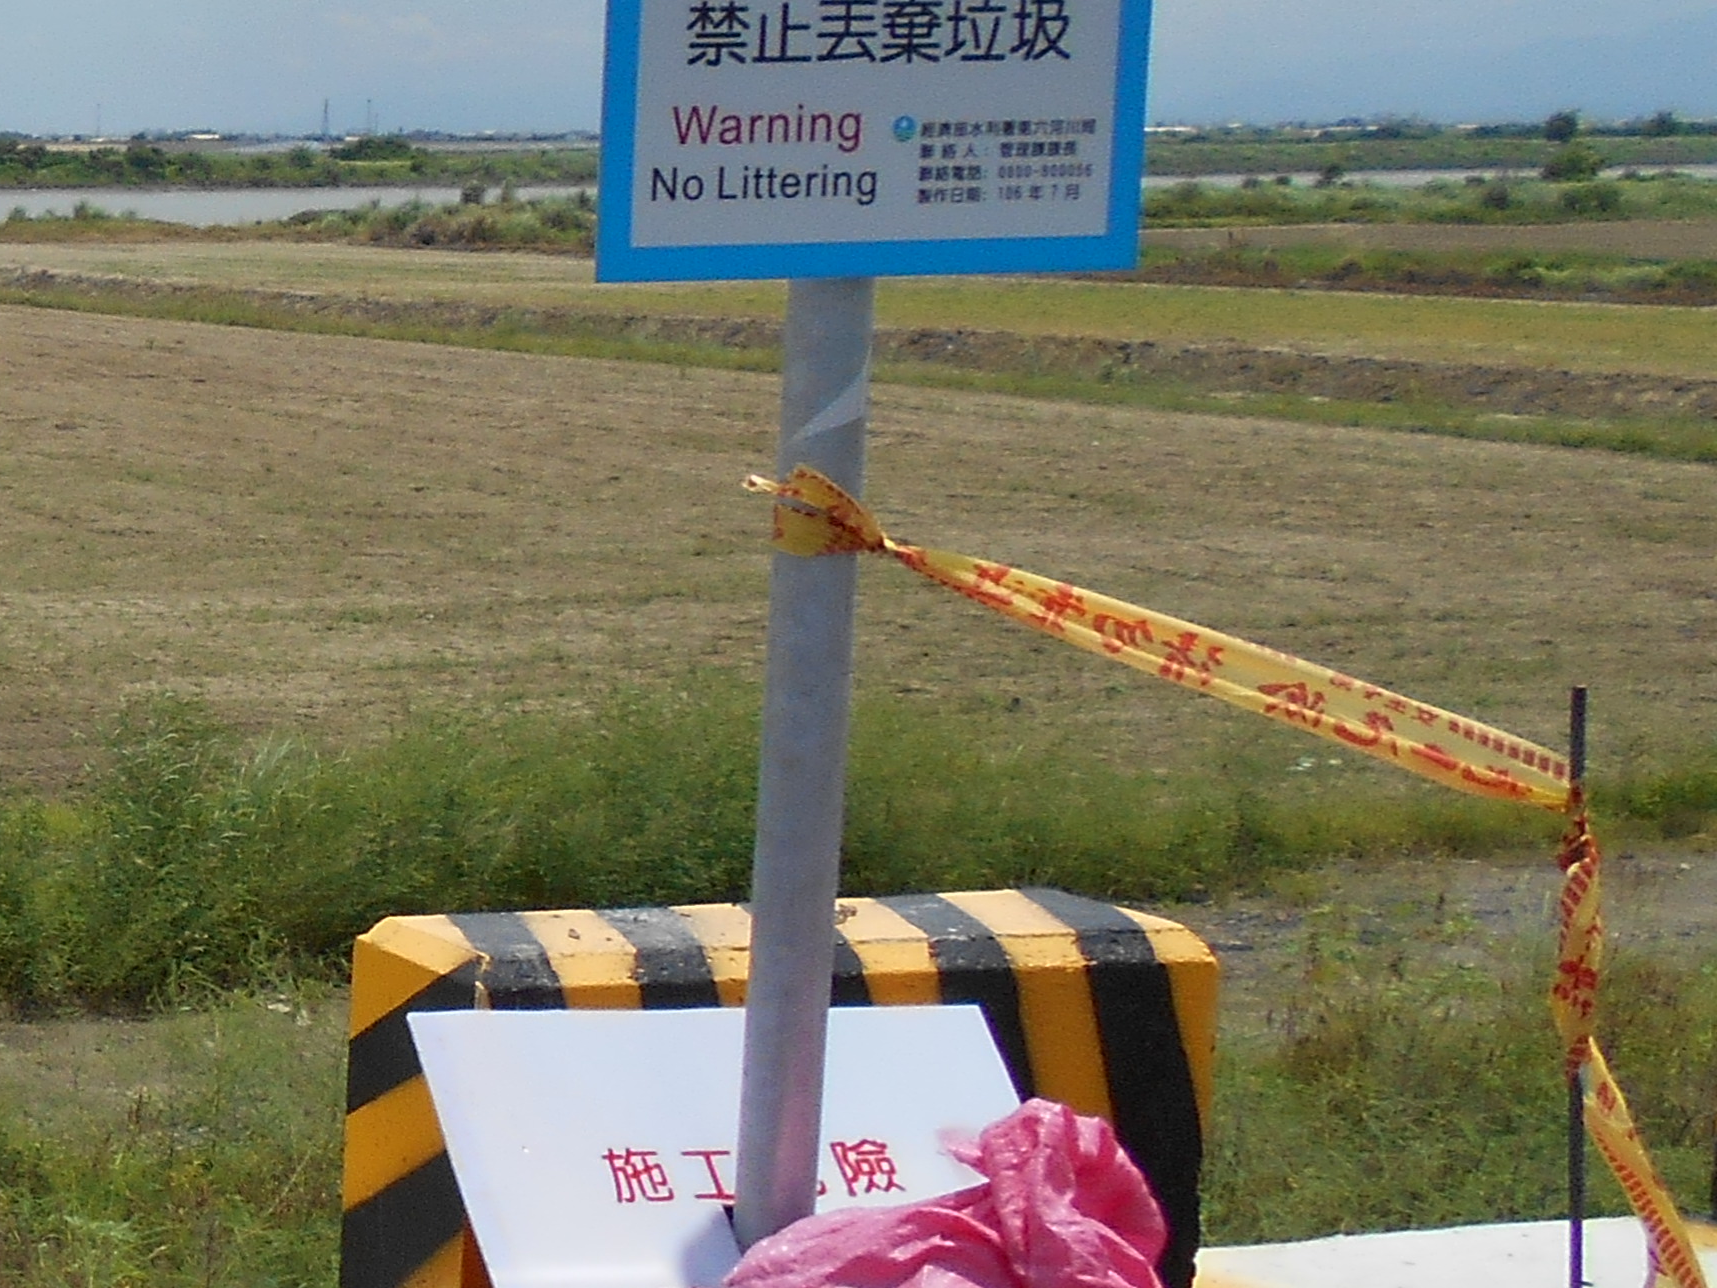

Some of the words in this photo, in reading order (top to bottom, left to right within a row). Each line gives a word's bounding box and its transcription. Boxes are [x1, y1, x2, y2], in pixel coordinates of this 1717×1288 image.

[672, 104, 863, 152] Warning
[650, 168, 704, 201] No
[716, 163, 878, 205] Littering
[603, 1139, 907, 1204] 施工險
